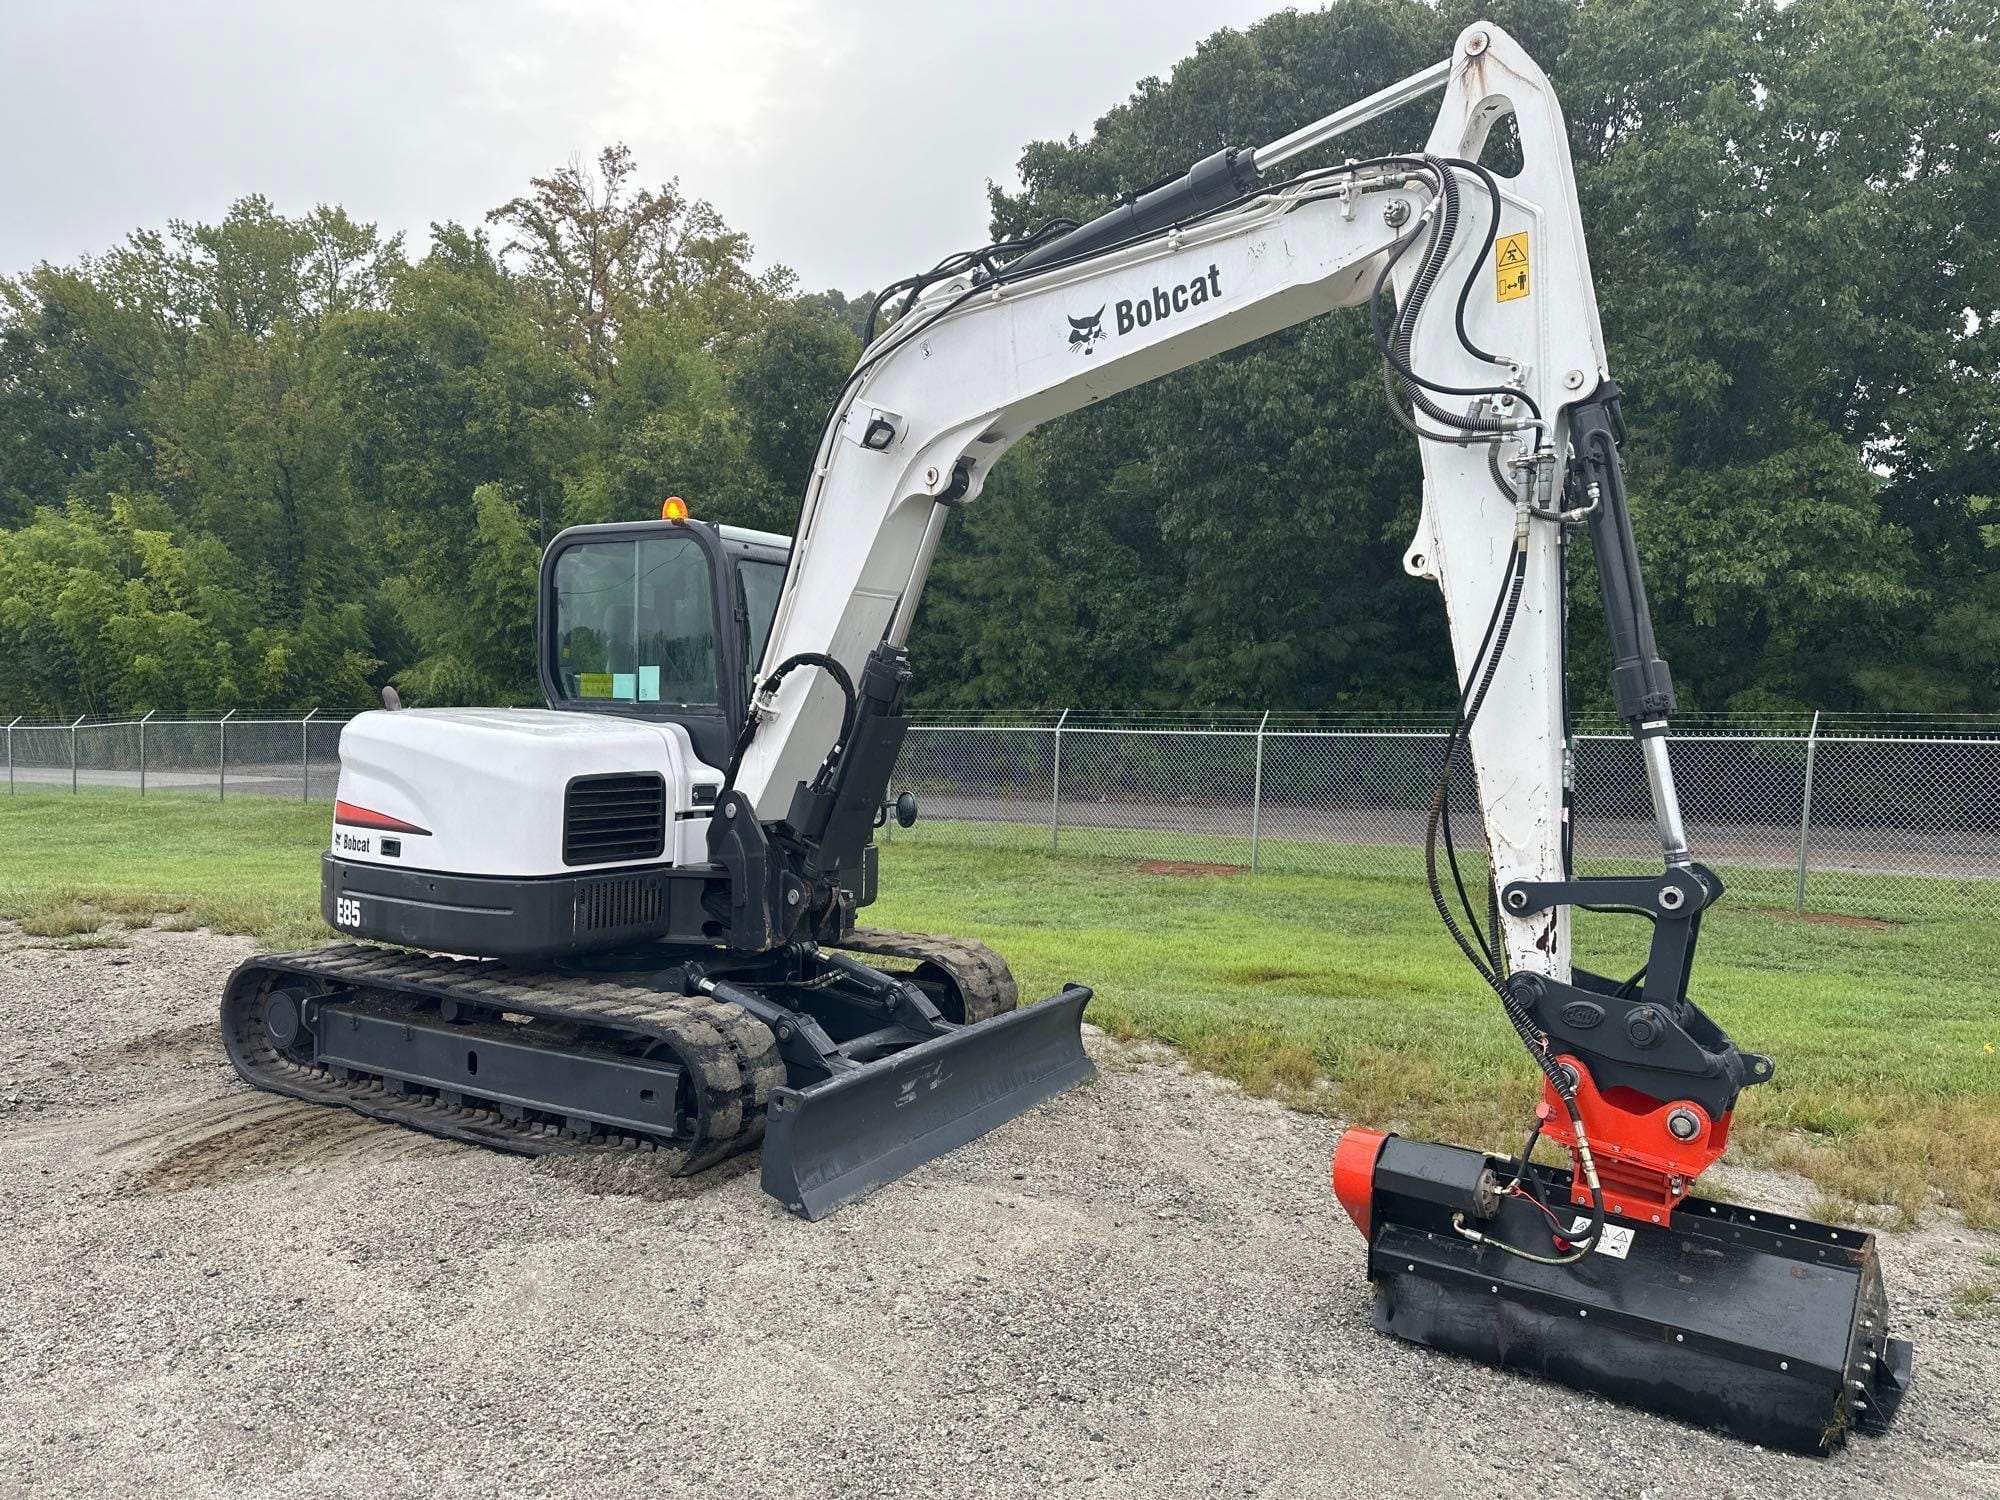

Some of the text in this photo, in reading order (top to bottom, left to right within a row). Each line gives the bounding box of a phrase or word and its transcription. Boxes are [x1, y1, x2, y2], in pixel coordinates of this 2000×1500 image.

[1115, 264, 1222, 336] Bobcat
[343, 834, 370, 853] Bobcat
[336, 897, 361, 928] E85
